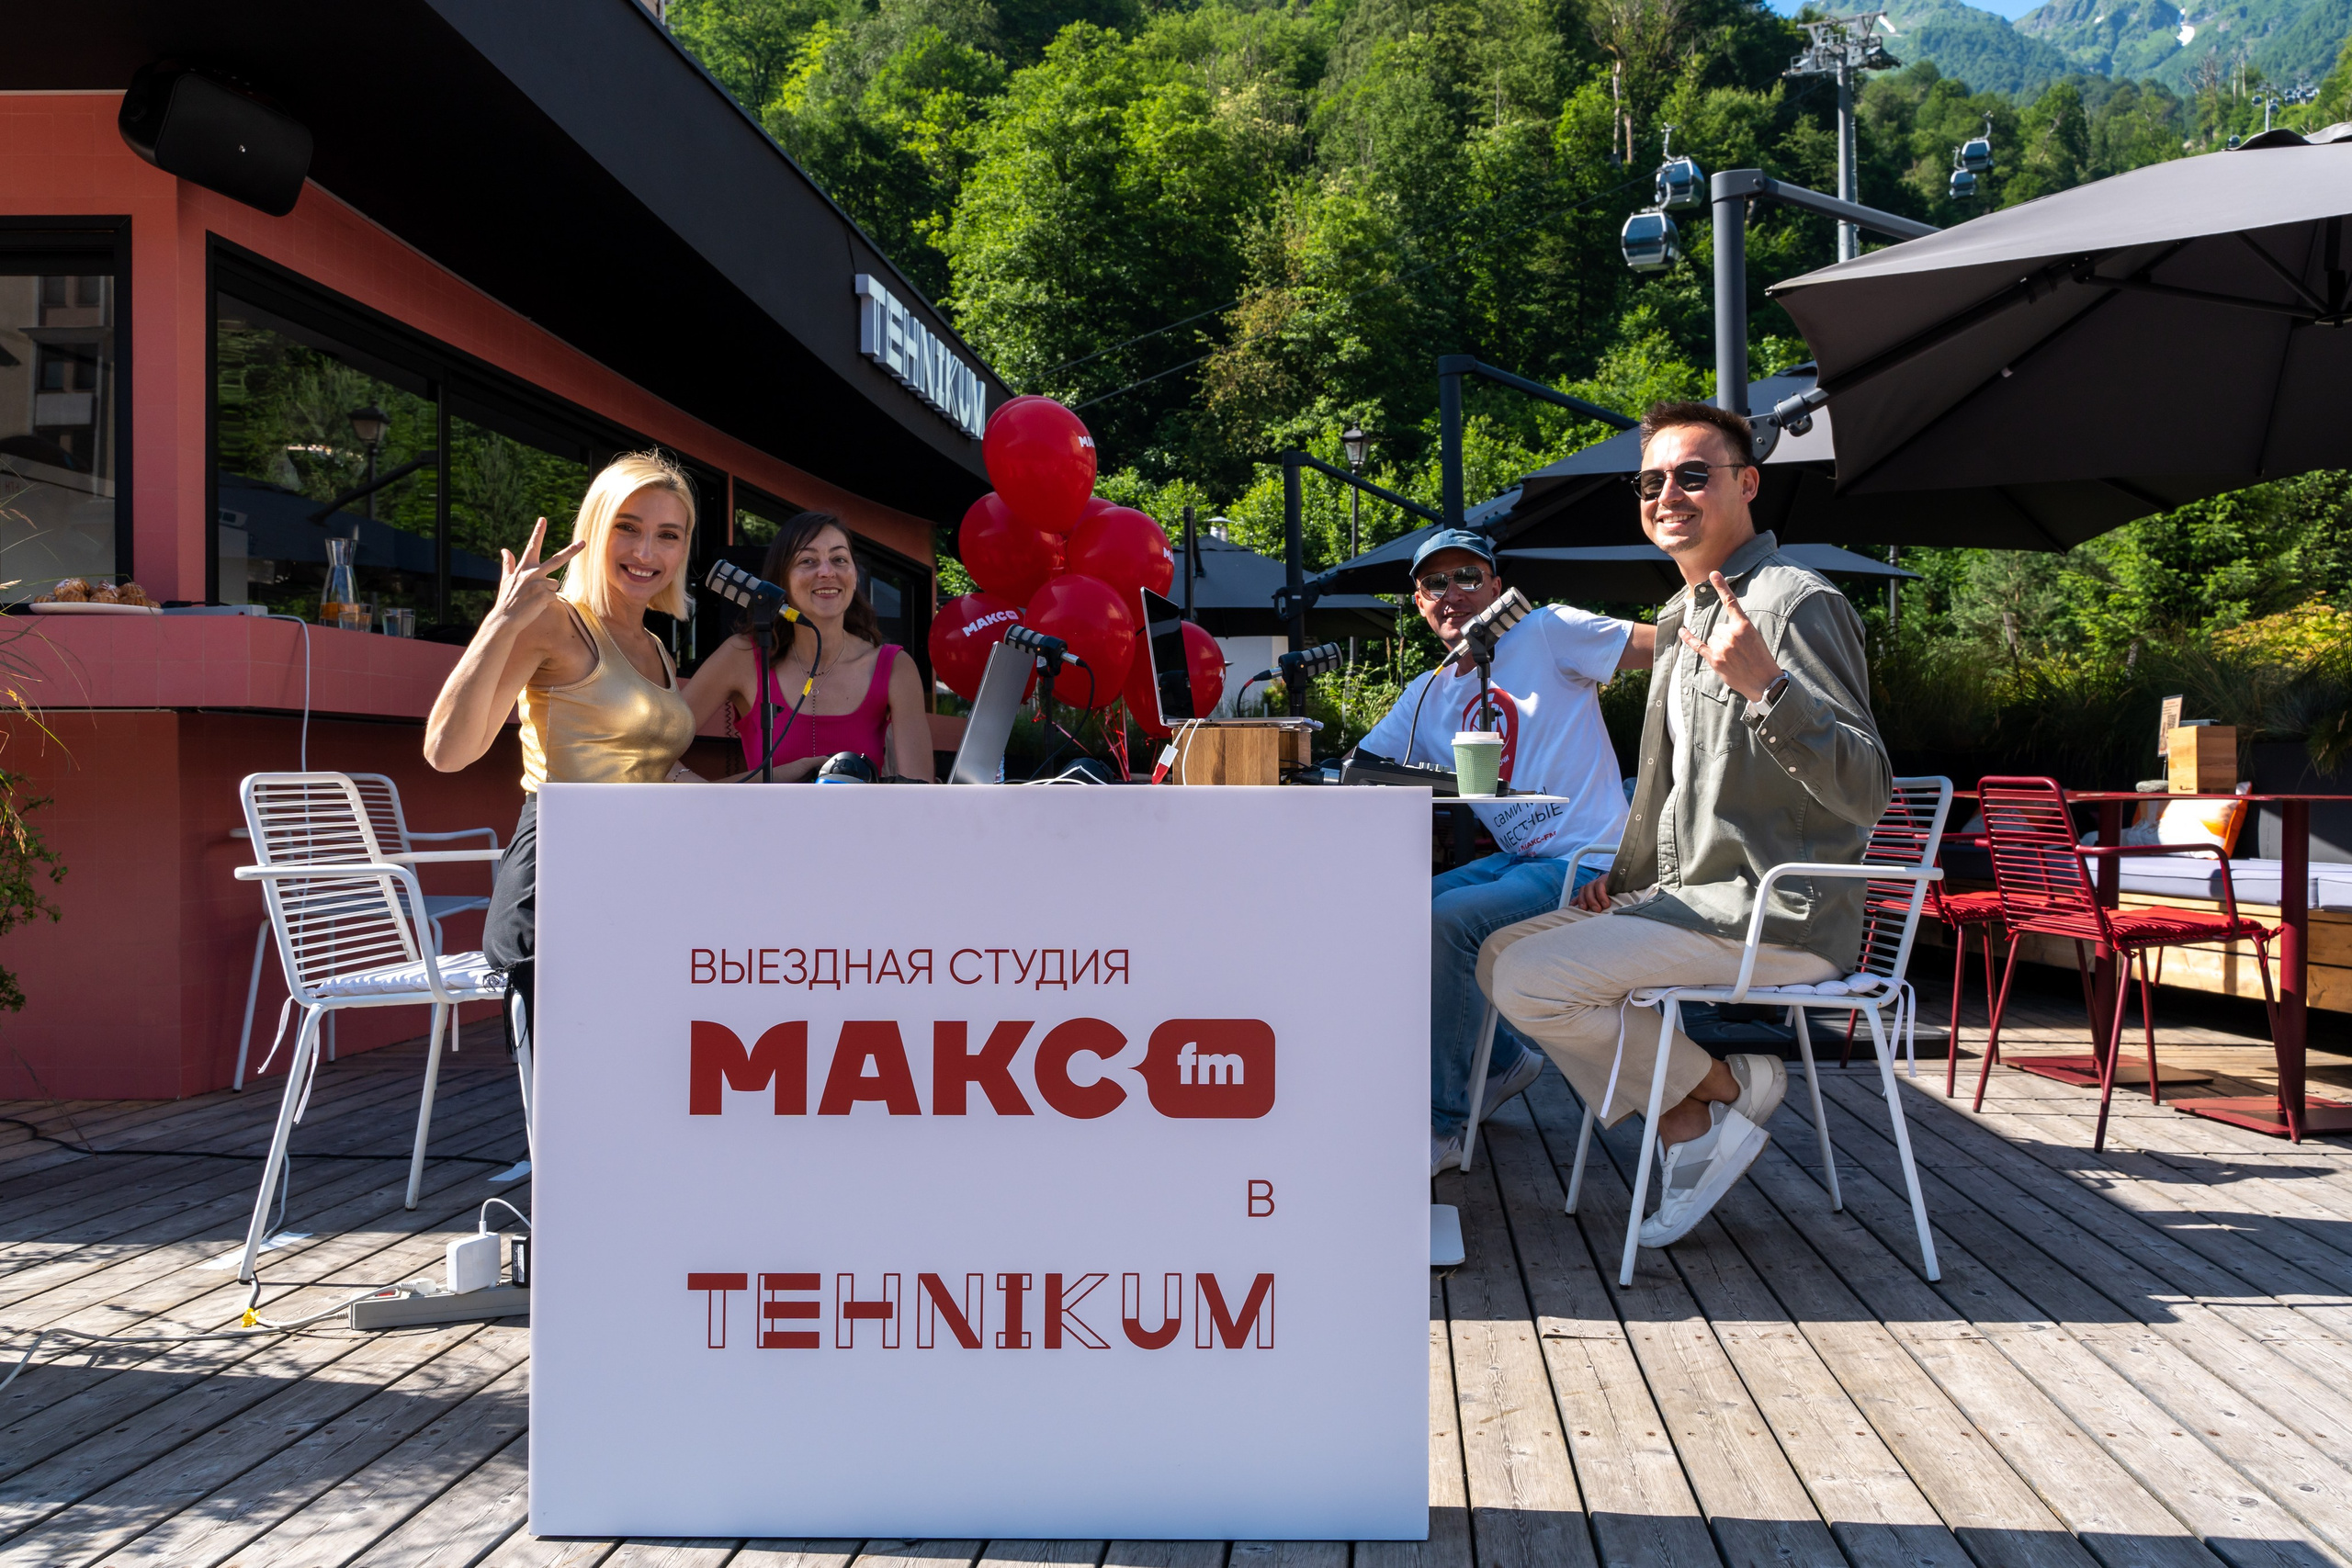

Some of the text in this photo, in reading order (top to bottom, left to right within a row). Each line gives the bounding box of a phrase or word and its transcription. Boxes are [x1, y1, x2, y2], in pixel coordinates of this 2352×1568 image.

[855, 274, 986, 440] TEHNIKUM
[1493, 802, 1522, 828] сами
[691, 948, 1130, 991] ВЫЕЗДНАЯ СТУДИЯ
[689, 1017, 1244, 1120] МАКС fm
[1248, 1179, 1275, 1218] В
[687, 1272, 1275, 1350] TEHNIKUM
